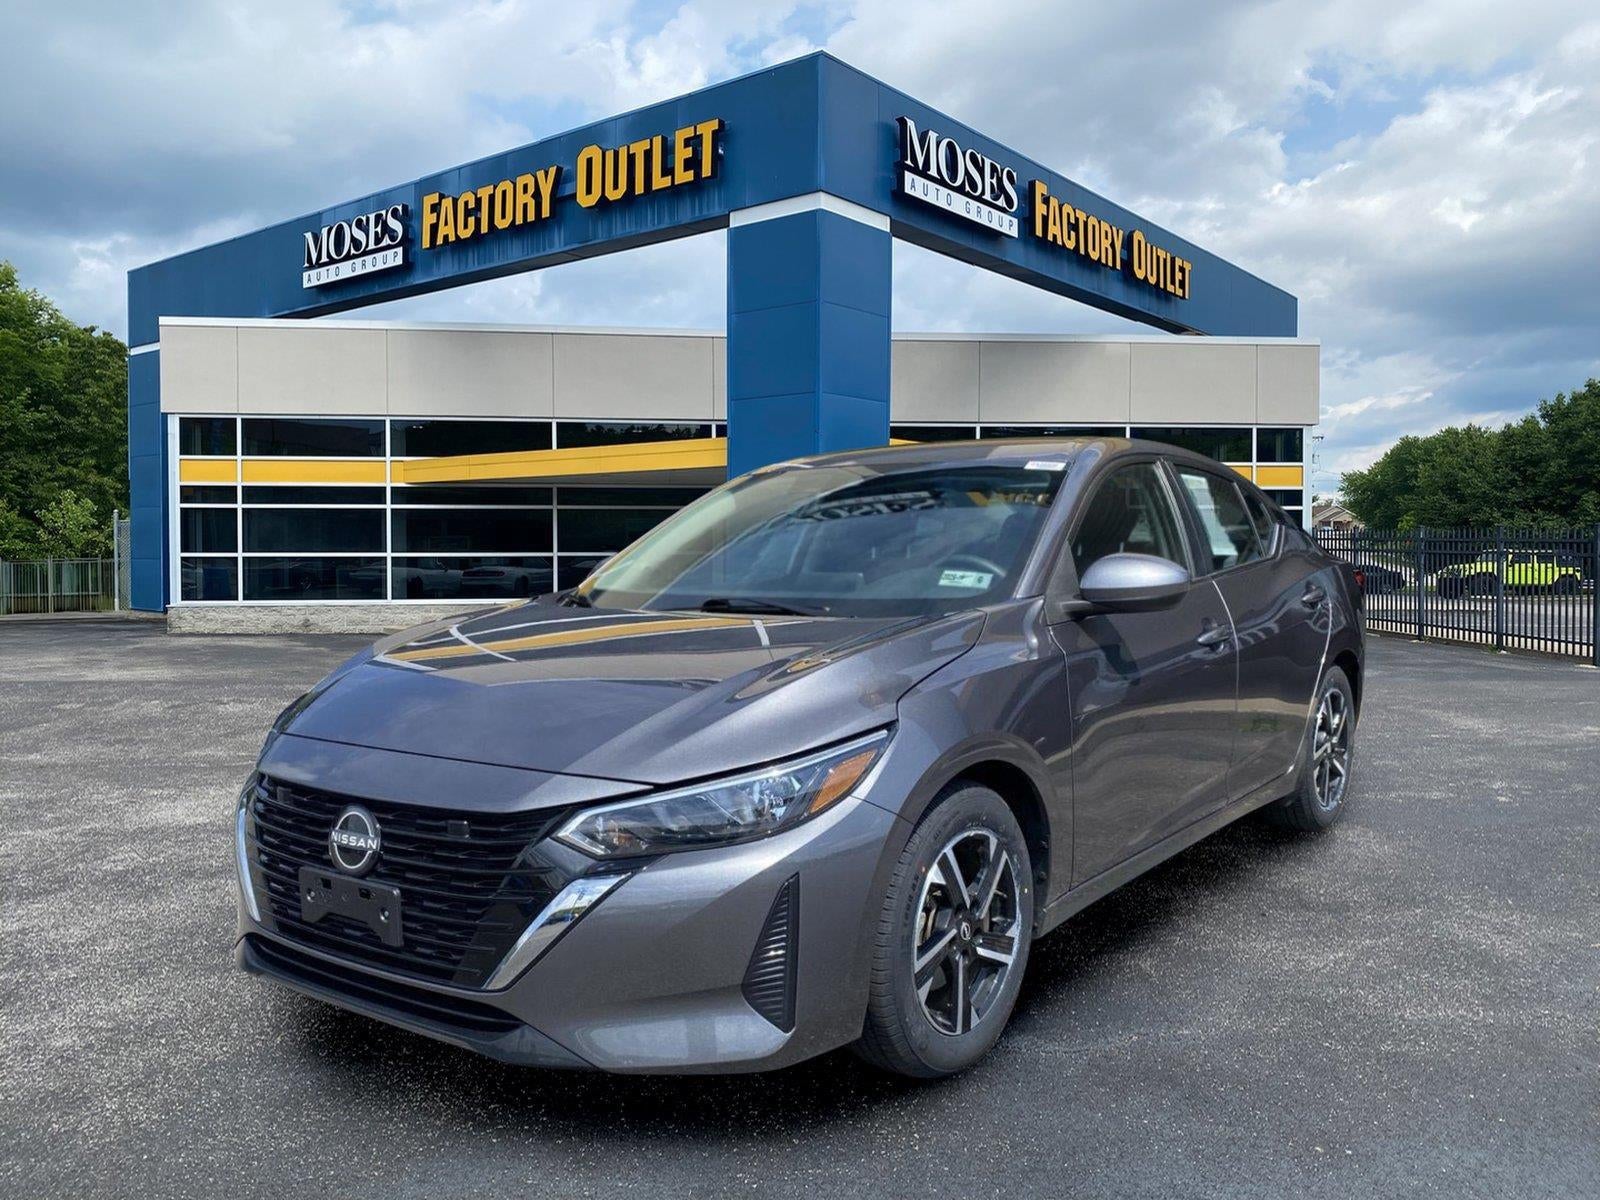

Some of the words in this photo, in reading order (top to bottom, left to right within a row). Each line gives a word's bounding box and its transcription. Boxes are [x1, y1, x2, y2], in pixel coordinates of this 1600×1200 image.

[421, 166, 559, 250] FACTORY
[576, 118, 720, 209] OUTLET
[903, 116, 1019, 212] MOSES
[303, 204, 403, 268] MOSES
[910, 177, 953, 206] AUTO
[965, 201, 1014, 231] GROUP
[307, 265, 340, 284] AUTO
[351, 250, 399, 273] GROUP
[1034, 179, 1124, 271] FACTORY
[1132, 228, 1192, 299] OUTLET
[331, 831, 377, 849] NISSAN
